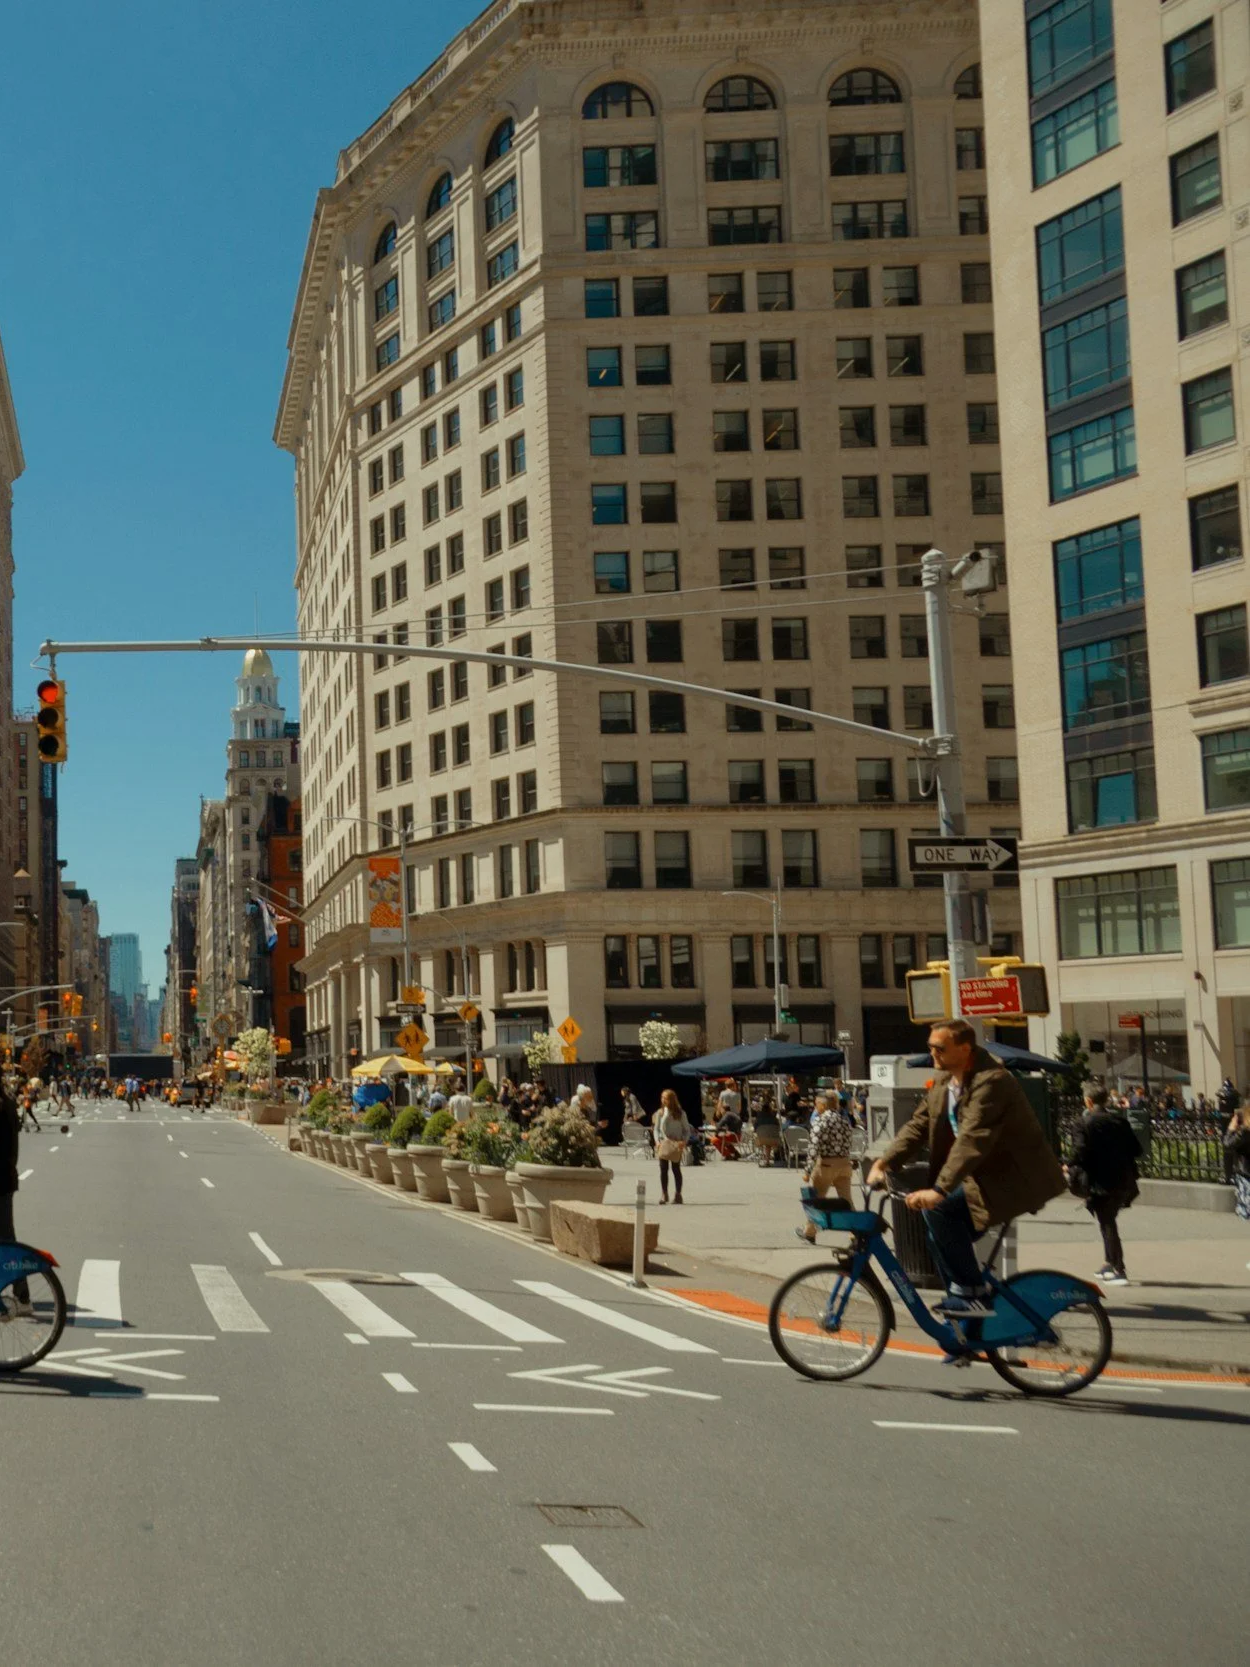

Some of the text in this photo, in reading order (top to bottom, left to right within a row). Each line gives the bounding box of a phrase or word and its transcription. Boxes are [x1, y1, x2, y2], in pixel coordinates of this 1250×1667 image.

[924, 848, 1001, 861] ONE WAY
[960, 980, 1009, 991] NO STANDING
